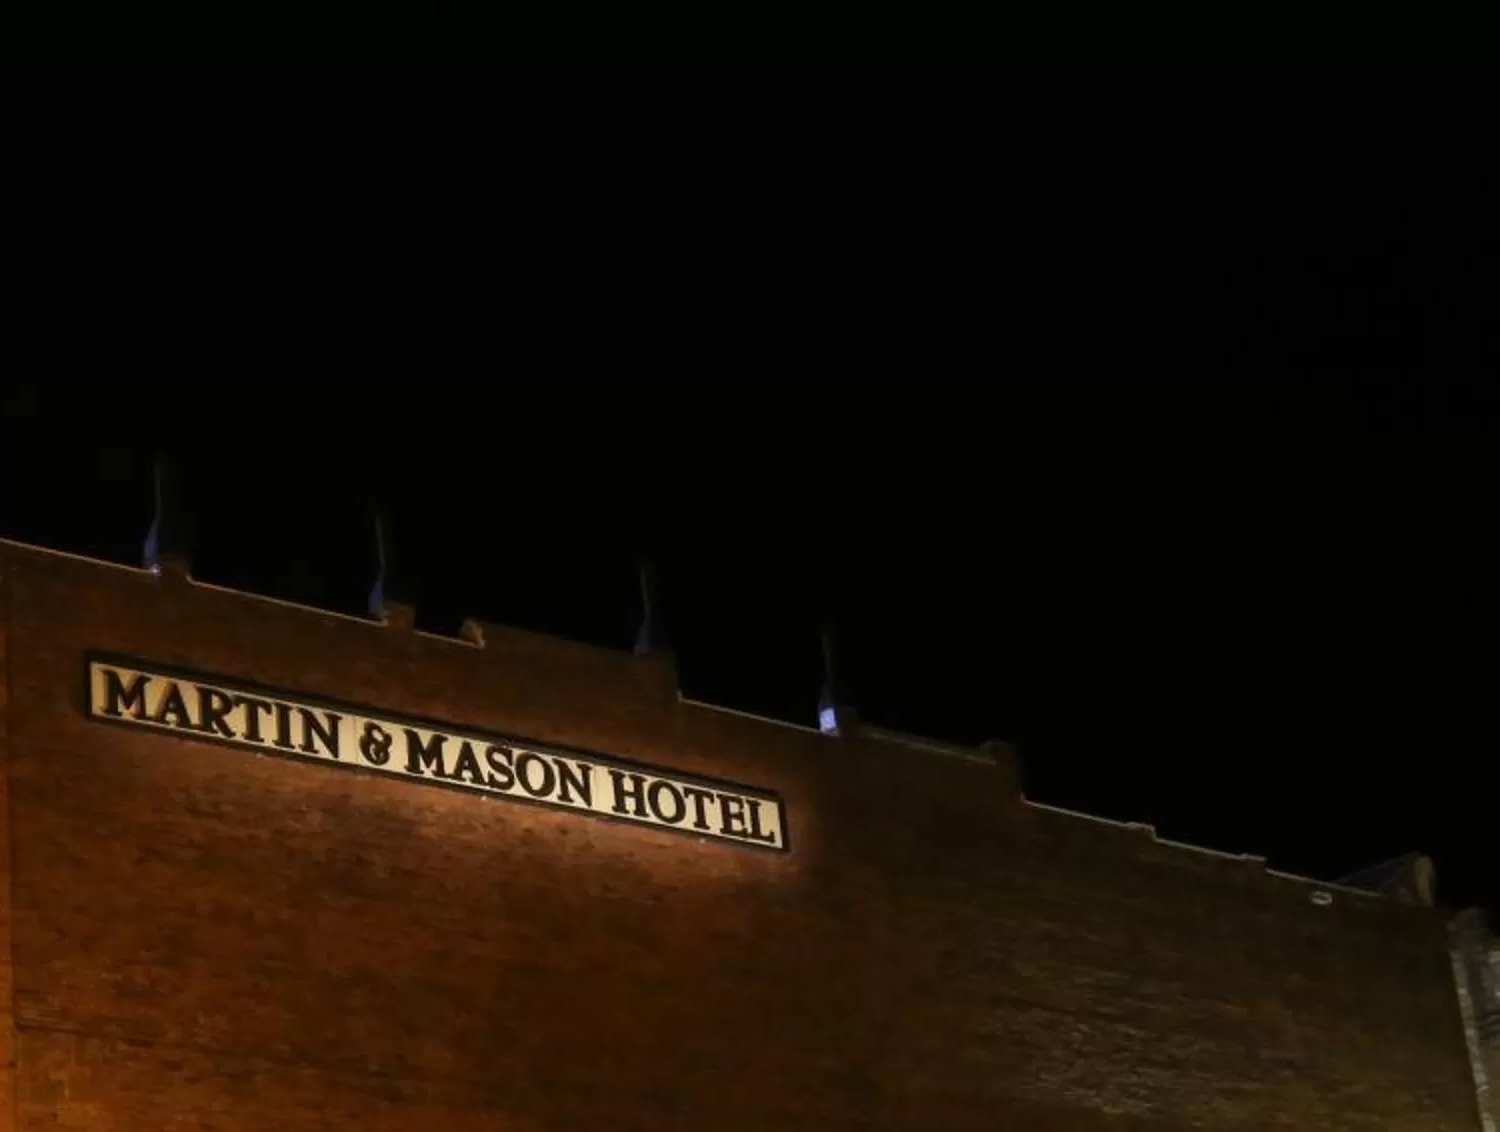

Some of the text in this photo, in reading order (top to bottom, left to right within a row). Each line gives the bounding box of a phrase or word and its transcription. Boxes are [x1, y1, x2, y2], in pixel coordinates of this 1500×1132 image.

[100, 669, 775, 843] MARTIN & MASON HOTEL
